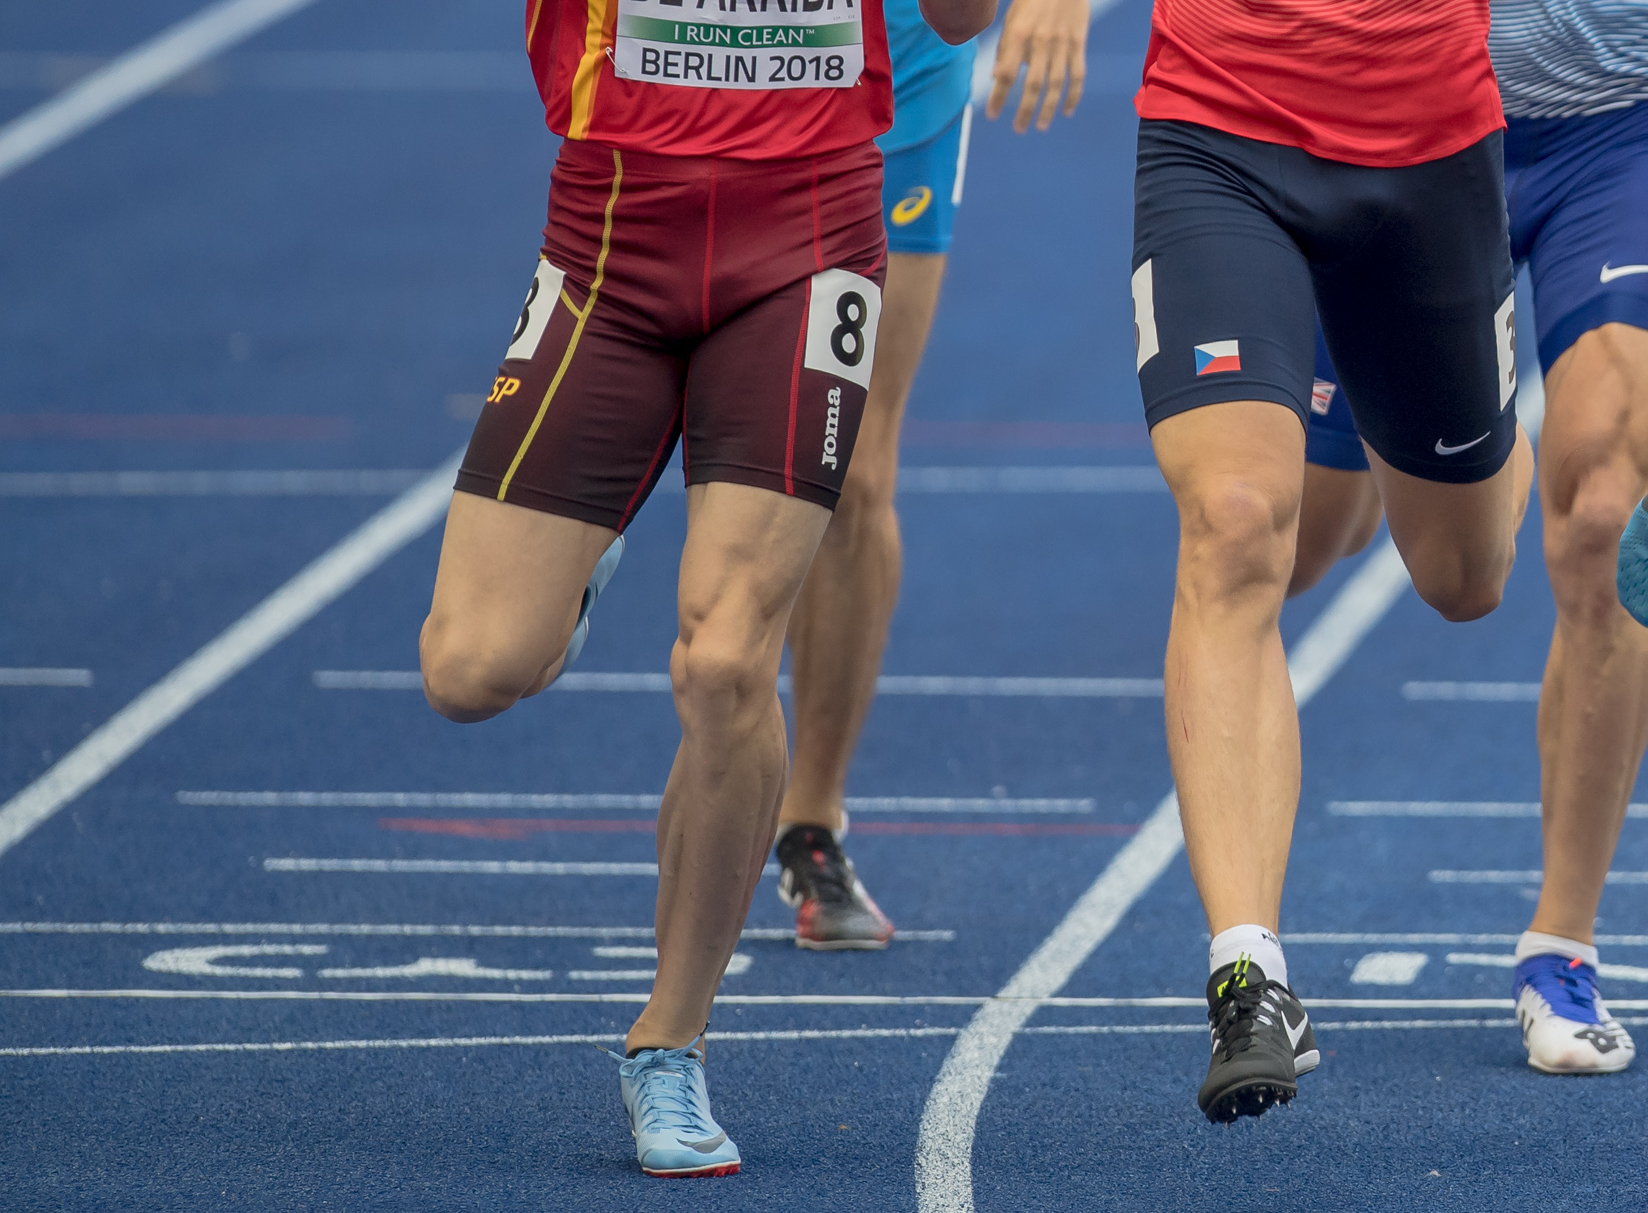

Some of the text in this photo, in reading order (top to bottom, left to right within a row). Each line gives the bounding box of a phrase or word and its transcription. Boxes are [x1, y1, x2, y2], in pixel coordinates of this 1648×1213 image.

[673, 23, 680, 42] I
[685, 25, 733, 45] RUN
[641, 48, 845, 84] BERLIN 2018
[830, 290, 868, 367] 8
[487, 376, 521, 404] SP
